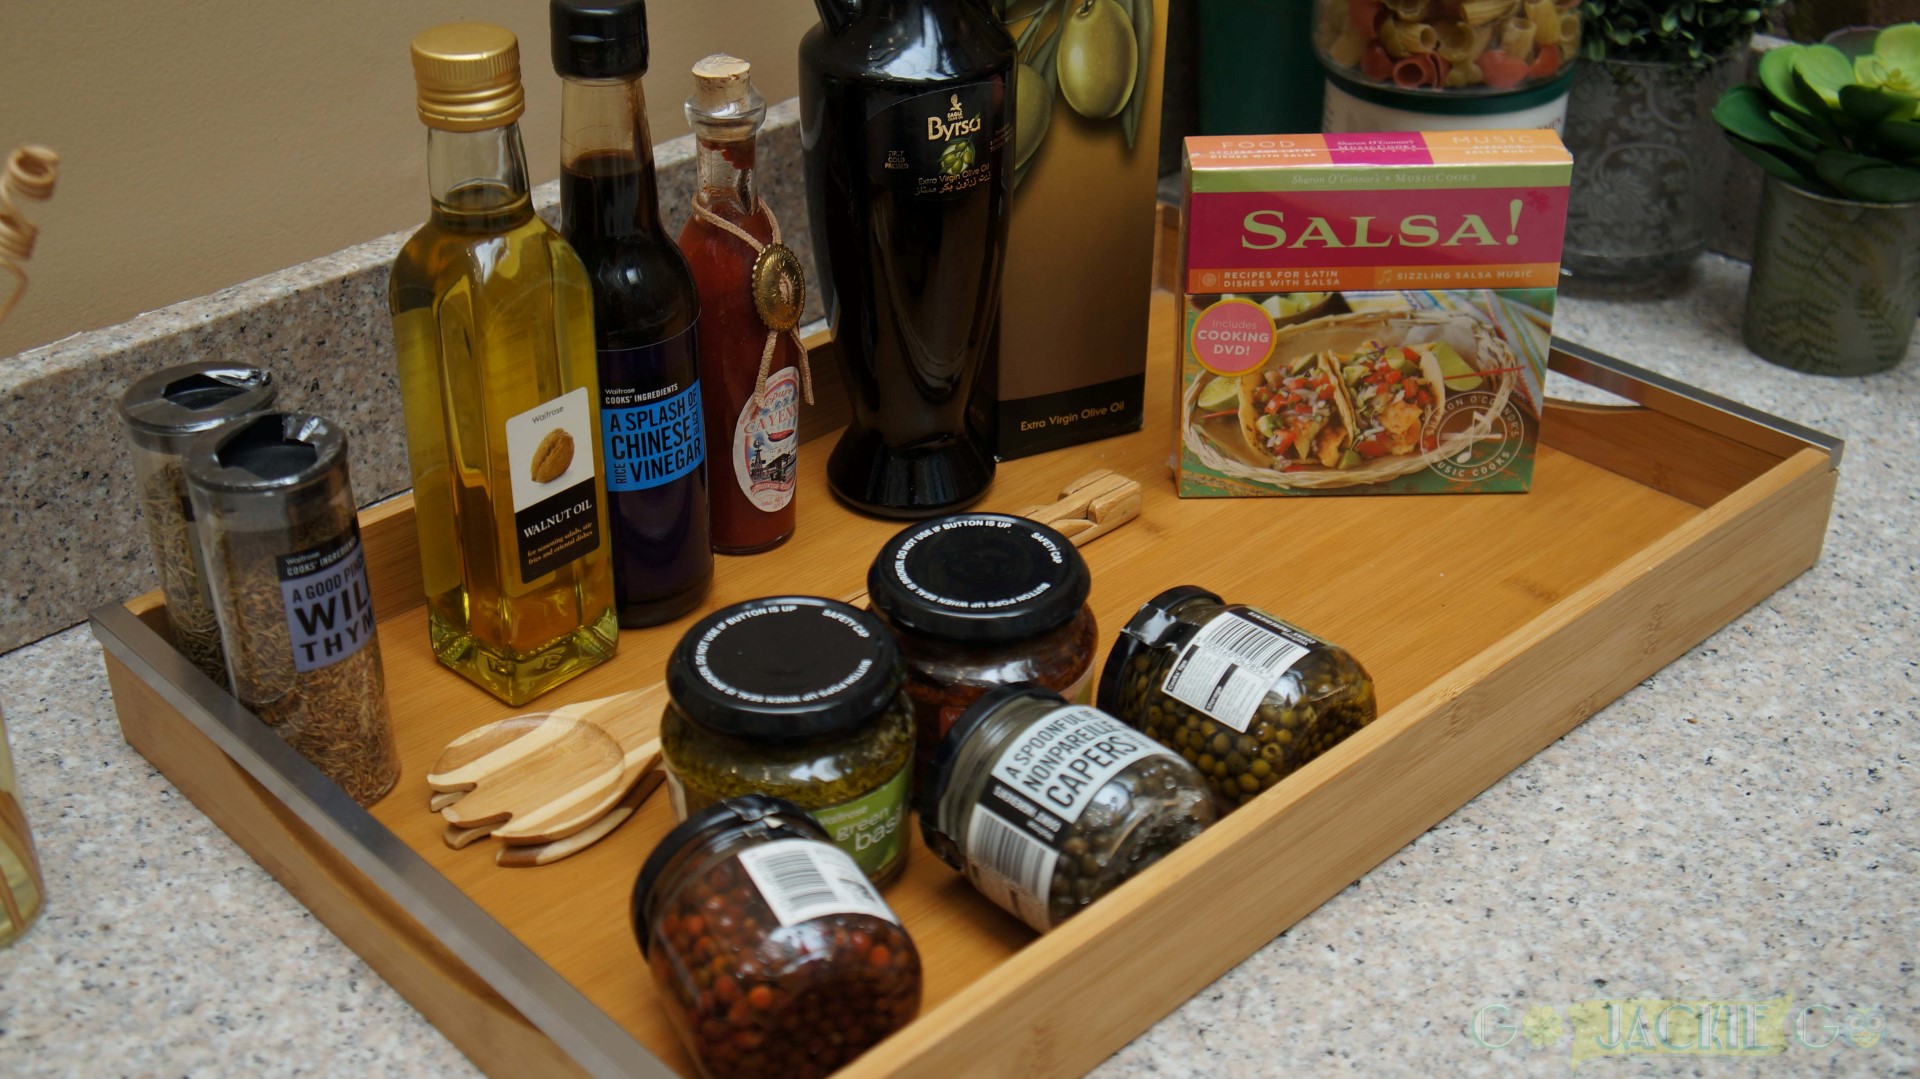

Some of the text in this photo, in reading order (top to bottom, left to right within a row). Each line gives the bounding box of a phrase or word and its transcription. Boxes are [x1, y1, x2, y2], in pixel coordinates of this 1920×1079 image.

[927, 116, 981, 142] Byrsa
[1452, 135, 1534, 144] MUSIC
[1222, 140, 1295, 150] FOOD
[918, 163, 990, 185] Extra Virgin Olive Oil
[1291, 172, 1326, 185] Sharon
[1328, 172, 1381, 184] O'Connor's
[1241, 199, 1524, 250] SALSA!
[1223, 270, 1339, 280] RECIPES FOR LATIN
[1223, 278, 1341, 288] DISHES WITH SALSA
[1396, 270, 1534, 281] SIZZLING SALSA MUSIC
[1197, 330, 1270, 344] COOKING
[1211, 319, 1258, 331] Includes
[1212, 343, 1251, 357] DVD!
[604, 388, 636, 396] Waitrose
[634, 383, 679, 402] INGREDIENTS
[532, 406, 565, 424] Waitrose
[610, 387, 698, 433] A SPLASH OF
[1020, 400, 1126, 432] Extra Virgin Olive Oil
[611, 415, 692, 461] CHINESE
[614, 462, 628, 485] RICE
[629, 437, 702, 484] VINEGAR
[1472, 451, 1511, 477] COOKS
[522, 498, 593, 539] WALNUT OIL
[914, 528, 934, 542] USE
[931, 525, 942, 534] IF
[942, 519, 984, 531] BUTTON
[985, 520, 995, 528] IS
[996, 521, 1012, 530] UP
[527, 548, 537, 558] for
[537, 536, 564, 554] seasoning
[528, 530, 593, 566] fries and oriental dishes
[1030, 531, 1063, 565] SAFETY CAP
[292, 588, 302, 604] A
[305, 574, 342, 600] GOOD
[702, 626, 720, 642] USE
[716, 620, 728, 632] IF
[726, 607, 768, 626] BUTTON
[768, 604, 780, 614] IS
[781, 604, 798, 614] UP
[821, 608, 870, 640] SAFETY CAP
[1004, 765, 1022, 780] A
[1015, 714, 1084, 766] SPOONFUL
[1022, 720, 1120, 794] NONPAREILLE
[1046, 735, 1139, 810] CAPERS
[836, 806, 890, 842] green
